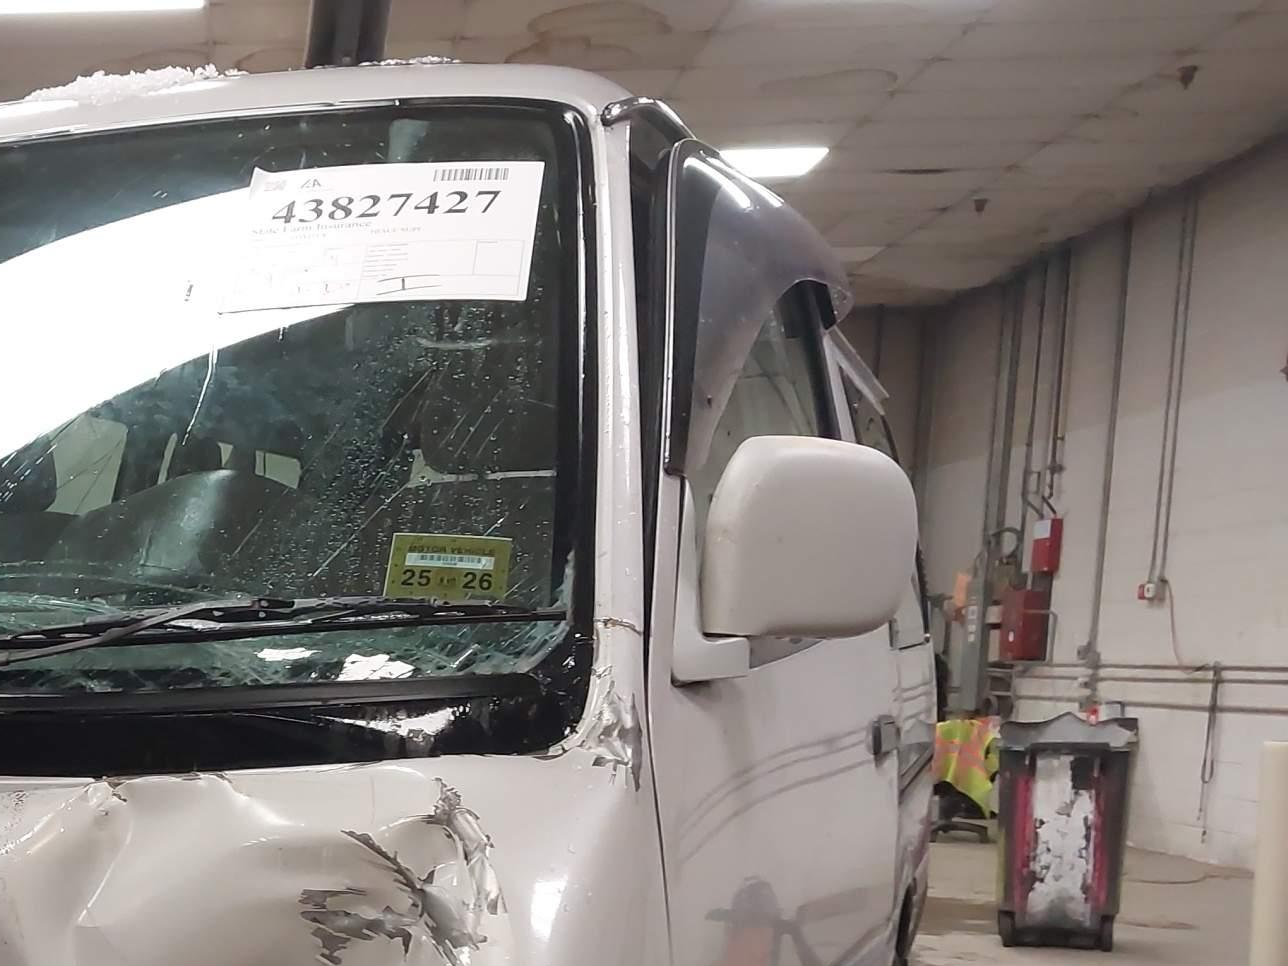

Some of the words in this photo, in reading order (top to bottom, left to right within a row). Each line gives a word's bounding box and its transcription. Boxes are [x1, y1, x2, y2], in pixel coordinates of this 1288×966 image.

[271, 190, 502, 225] 43827427
[408, 544, 447, 554] MOTOR
[450, 546, 496, 556] VEHICLE
[400, 569, 432, 587] 25
[462, 571, 493, 591] 26
